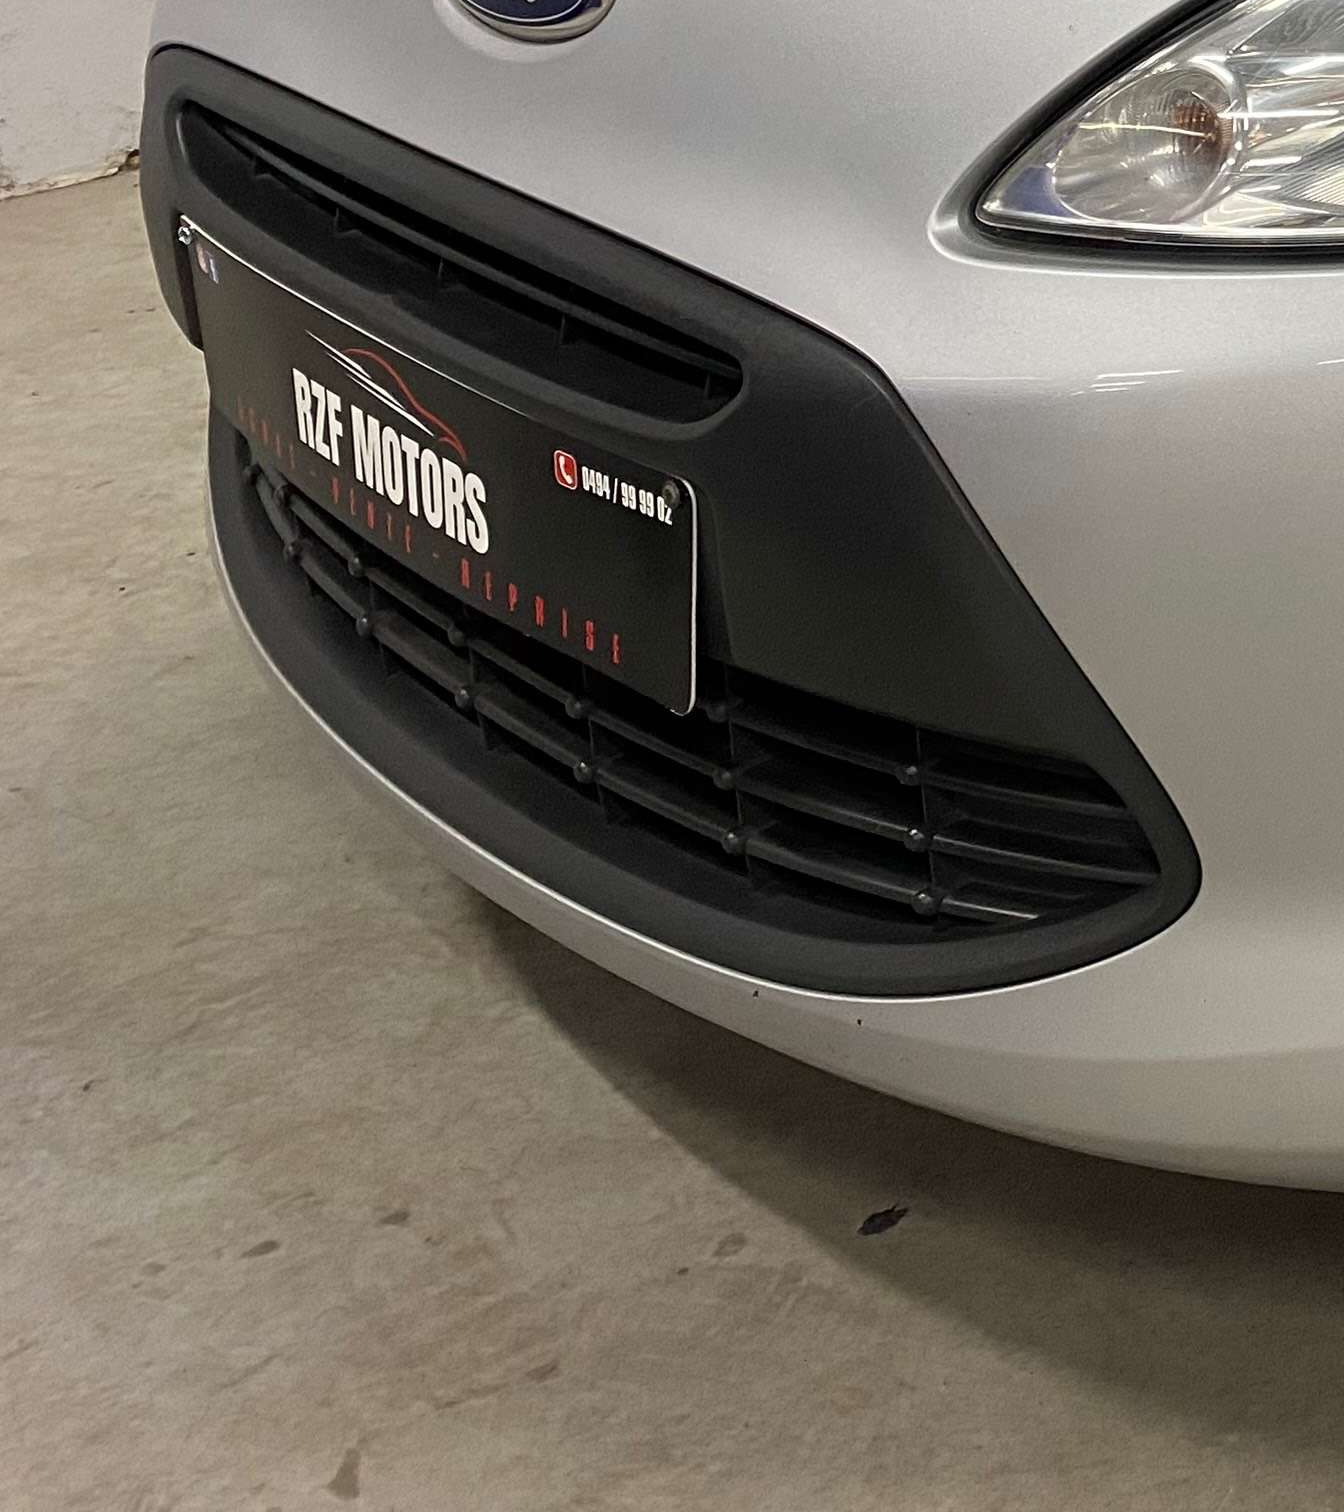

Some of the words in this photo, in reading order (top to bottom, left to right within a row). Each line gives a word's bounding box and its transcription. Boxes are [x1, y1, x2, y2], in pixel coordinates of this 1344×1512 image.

[292, 367, 344, 467] RZF
[350, 403, 490, 555] MOTORS
[581, 465, 611, 501] 0494
[620, 481, 637, 511] 99
[638, 488, 655, 518] 99
